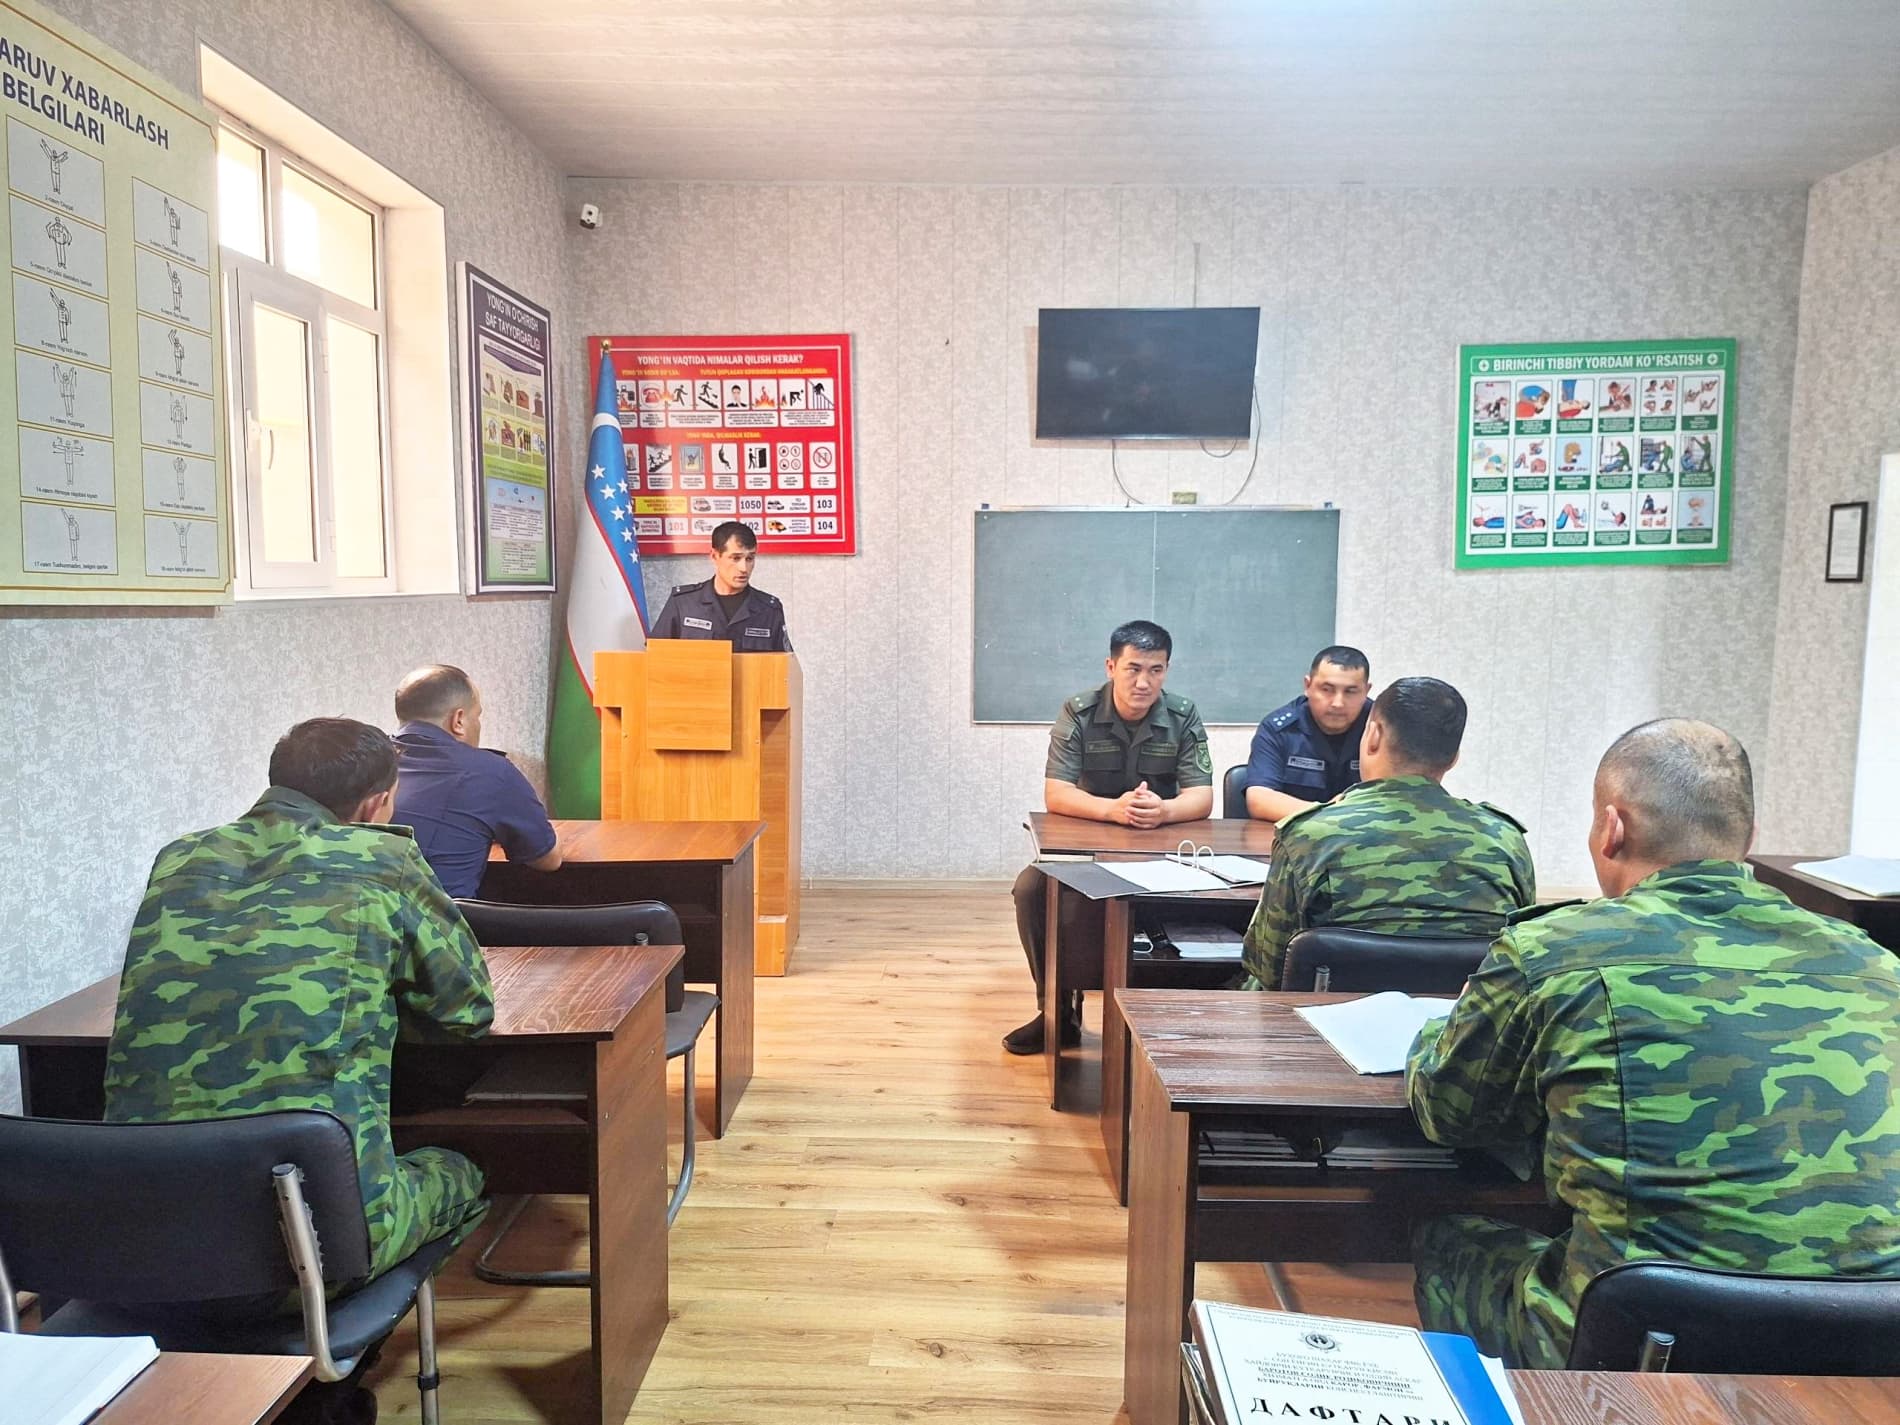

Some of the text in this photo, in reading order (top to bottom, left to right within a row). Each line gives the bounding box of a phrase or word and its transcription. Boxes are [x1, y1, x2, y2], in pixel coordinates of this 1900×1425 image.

[0, 37, 169, 150] ARUV XABARLASH
[3, 71, 105, 145] BELGILARI
[485, 311, 497, 329] SAF
[638, 354, 803, 366] YONG'IN VAQTIDA NIMALAR QILISH KERAK?
[1493, 354, 1704, 372] BIRINCHI TIBBIY YORDAM KO'RSATISH
[740, 500, 762, 510] 1050
[817, 499, 833, 509] 103
[668, 522, 684, 531] 101
[745, 522, 760, 531] 02
[817, 521, 833, 530] 104
